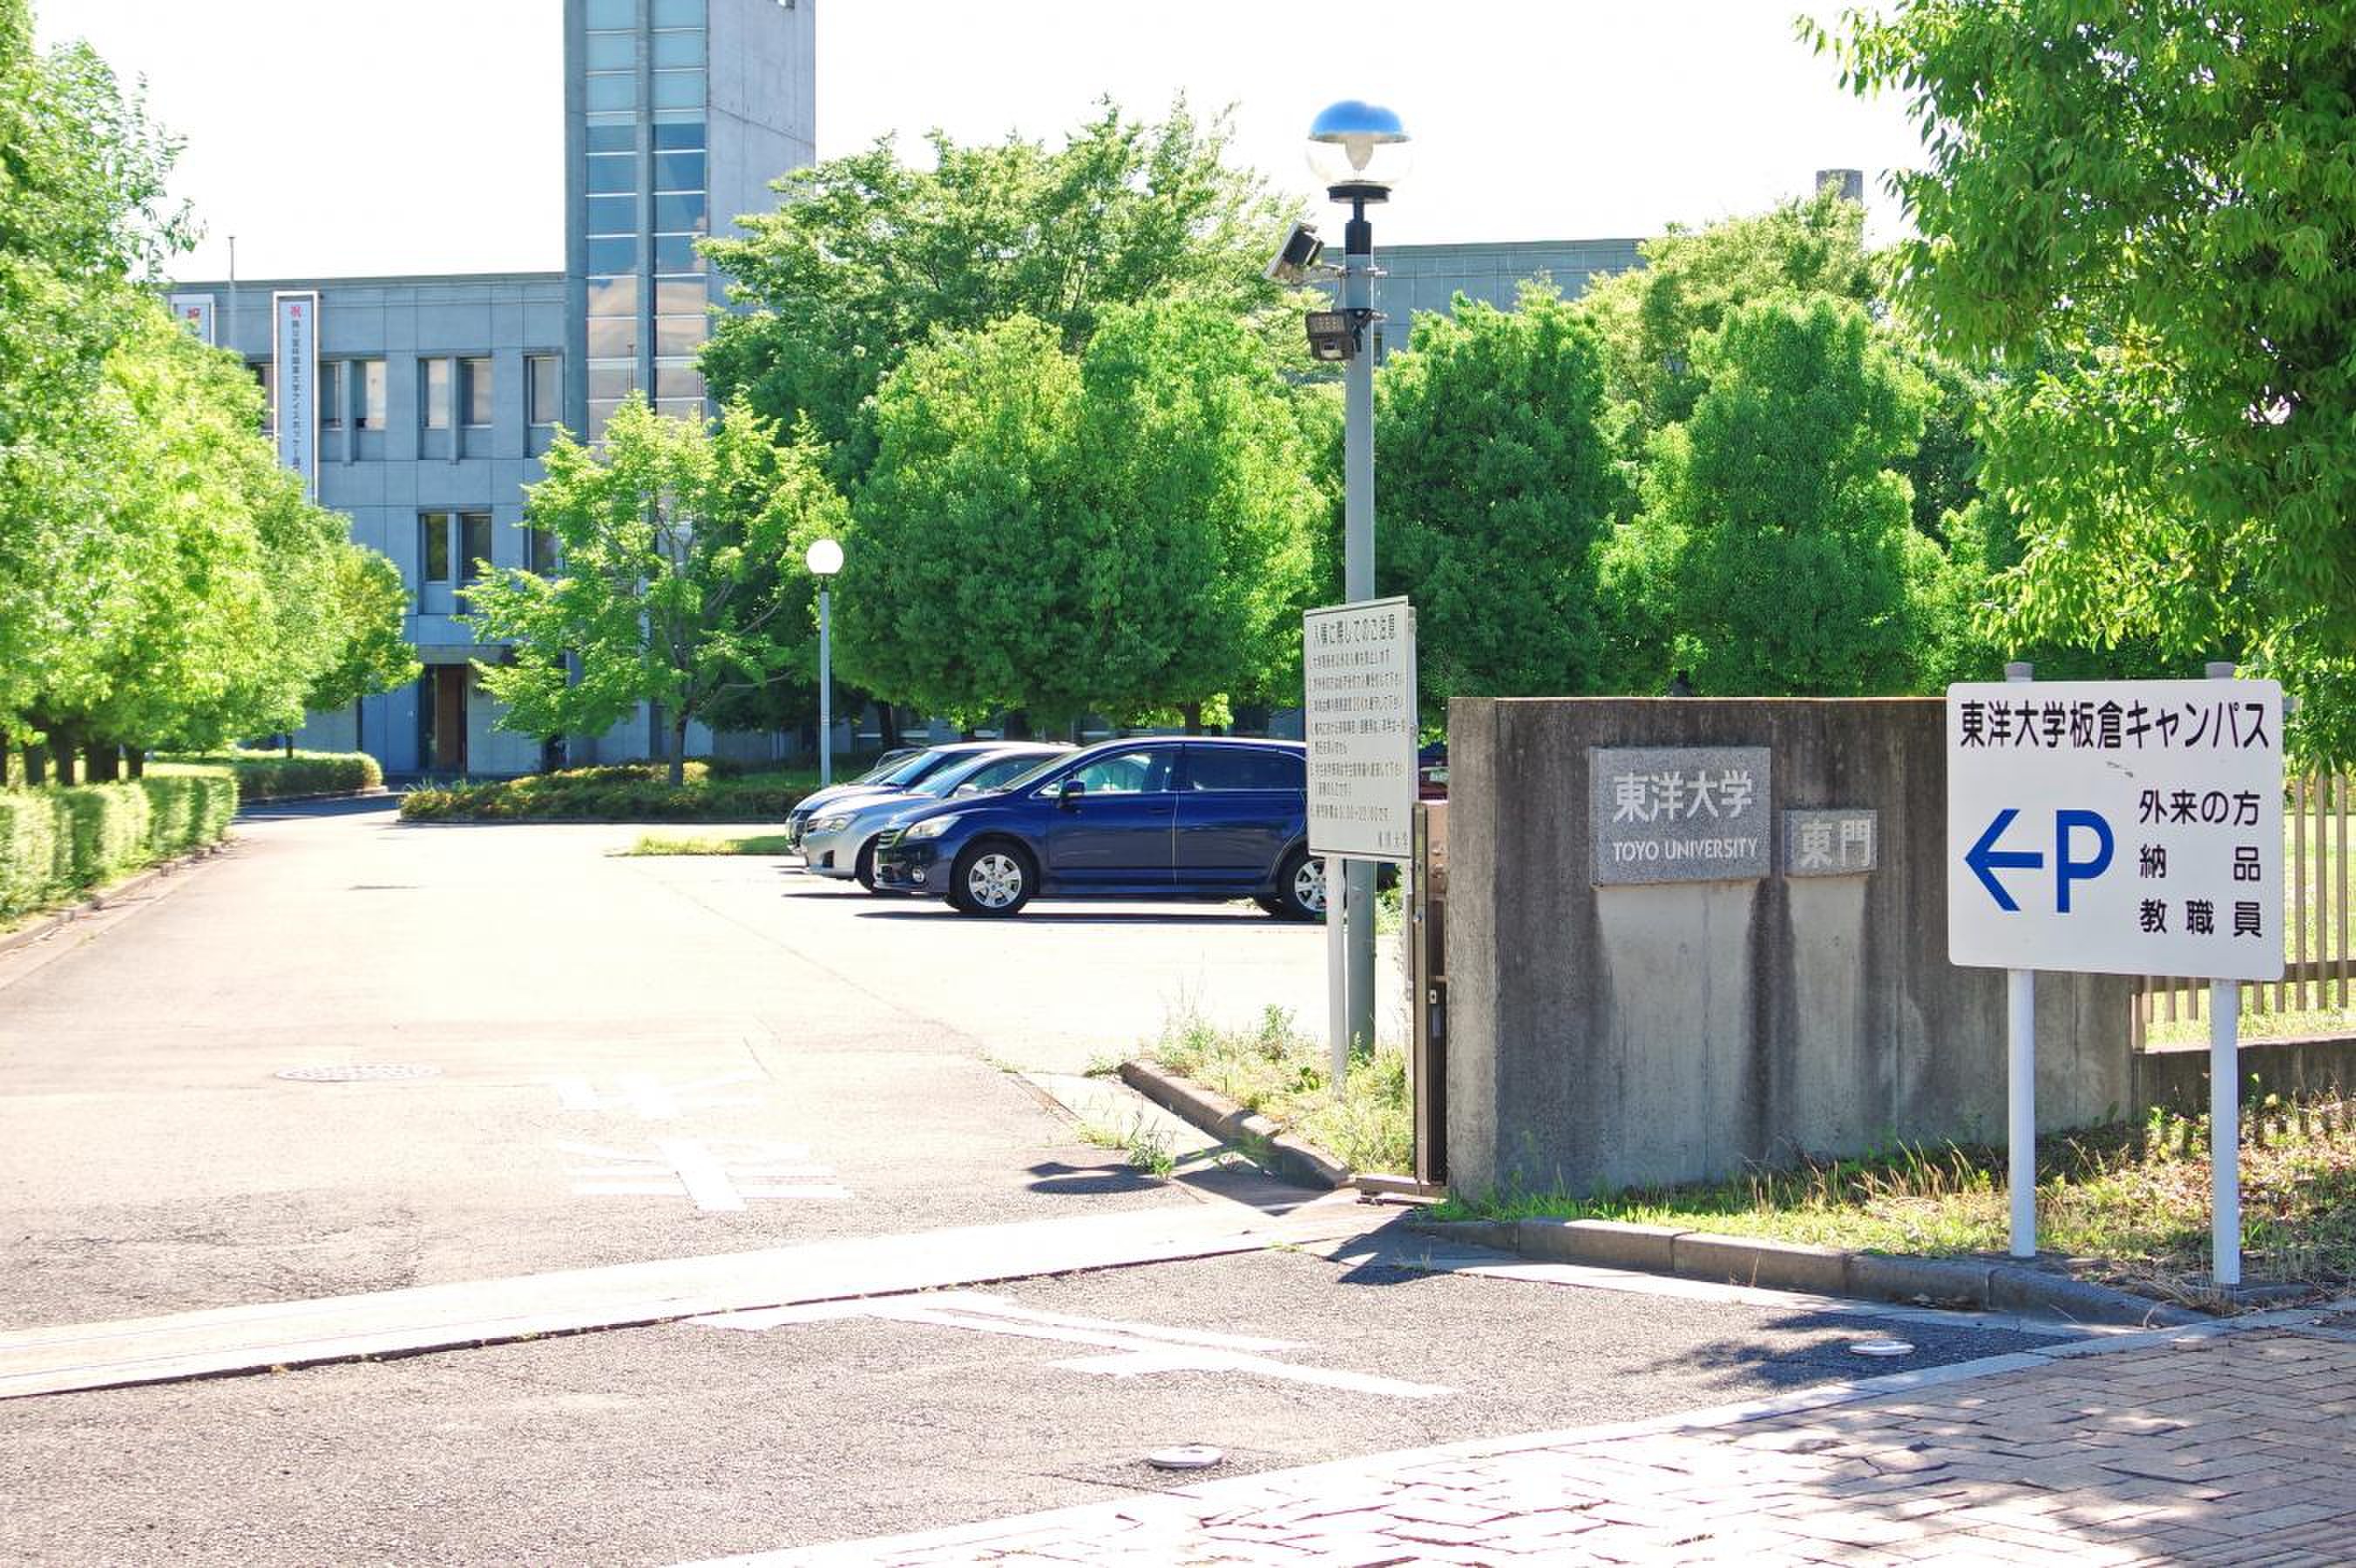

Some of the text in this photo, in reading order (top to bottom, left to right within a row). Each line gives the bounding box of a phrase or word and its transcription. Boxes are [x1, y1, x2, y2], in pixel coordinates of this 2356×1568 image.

[1960, 700, 2270, 749] 東洋大学板倉キャンパス
[1611, 769, 1753, 823] 東洋大学
[2138, 789, 2262, 827] 外来の方
[1612, 836, 1759, 862] TOYO UNIVERSITY
[1797, 818, 1872, 868] 東門
[2056, 809, 2116, 914] P
